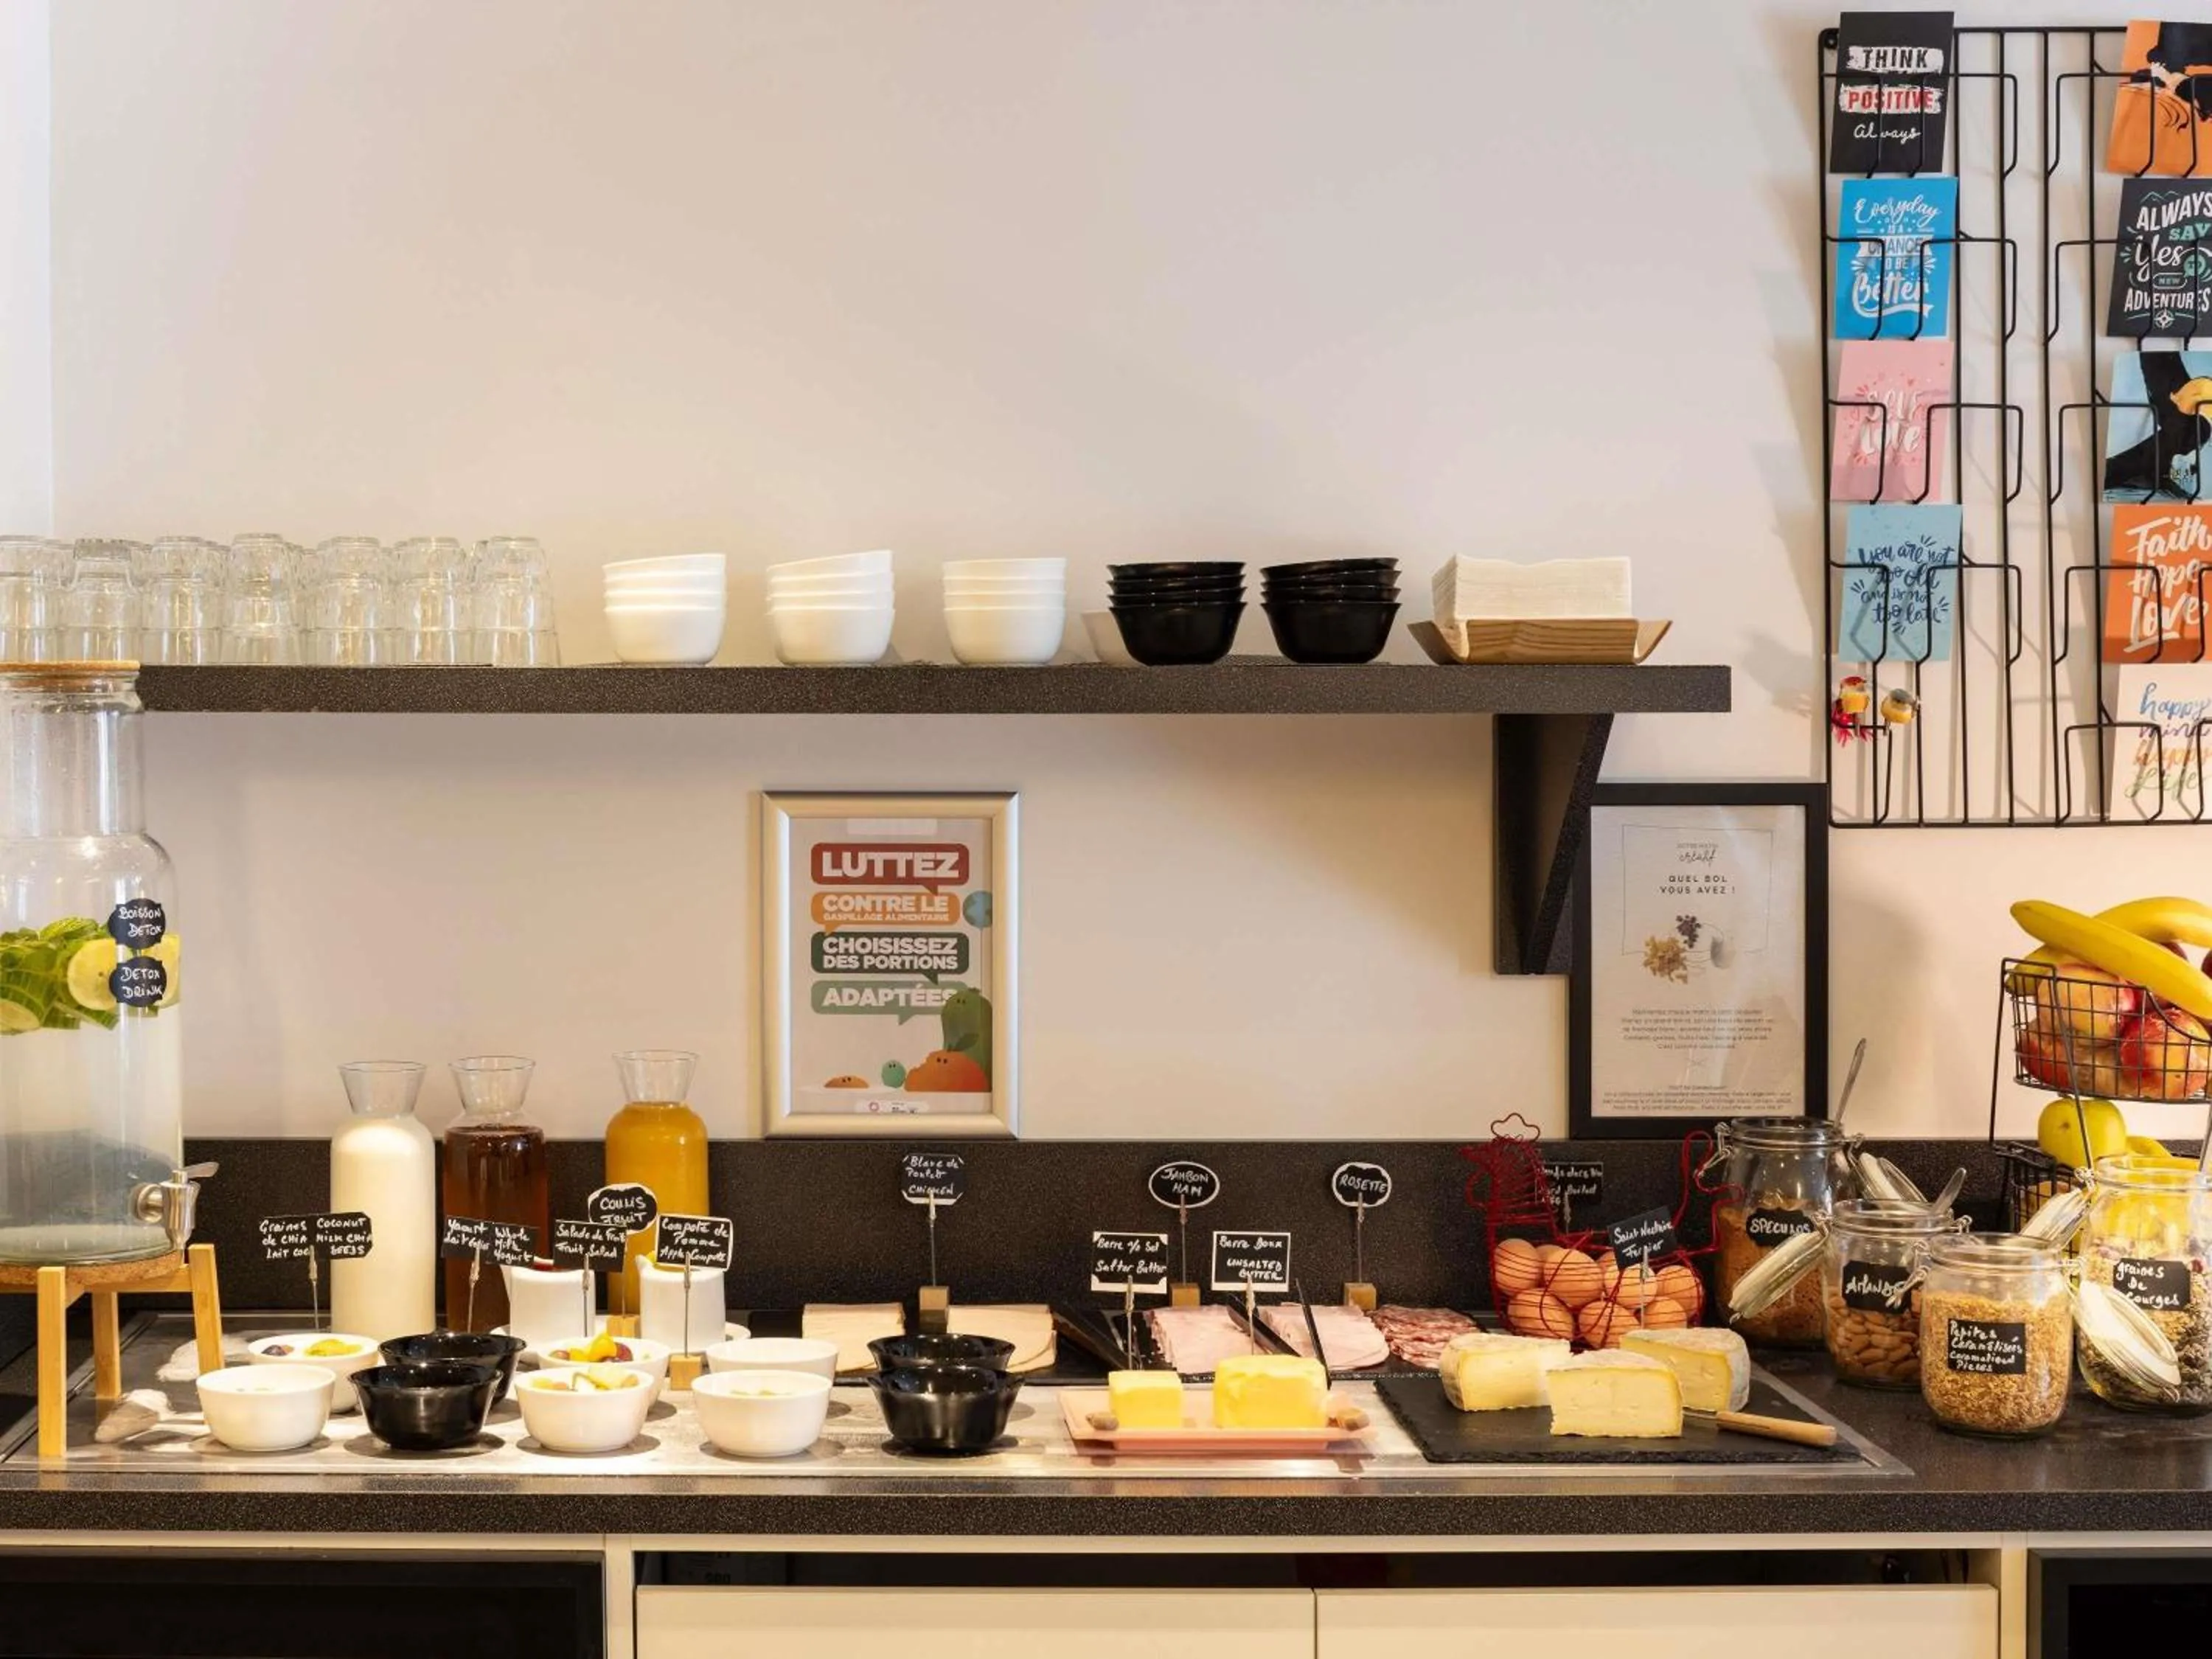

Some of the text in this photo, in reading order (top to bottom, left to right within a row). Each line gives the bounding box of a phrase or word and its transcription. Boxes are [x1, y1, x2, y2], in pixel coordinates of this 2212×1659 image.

[1863, 49, 1927, 68] THINK
[1848, 91, 1933, 111] POSITIVE
[1854, 194, 1941, 228] Everyday
[2135, 191, 2212, 232] ALWAYS
[2168, 223, 2212, 242] SAY
[2135, 234, 2184, 282] Yes
[2157, 276, 2180, 285] NEW
[822, 851, 959, 878] LUTTEZ
[1669, 874, 1728, 883] QUEL BOL
[1659, 886, 1691, 894] VOUS
[1697, 886, 1727, 894] AVEZ
[822, 894, 949, 914] CONTRE LE
[128, 923, 162, 937] DETOX
[822, 936, 958, 955] CHOISISSEZ
[823, 956, 959, 970] DES PORTIONS
[120, 967, 160, 981] DETOX
[1161, 1167, 1209, 1183] JAMBON
[1339, 1174, 1388, 1194] ROSETTE
[1172, 1183, 1202, 1196] HAM
[600, 1197, 647, 1211] COULIS
[2115, 1262, 2165, 1281] graines
